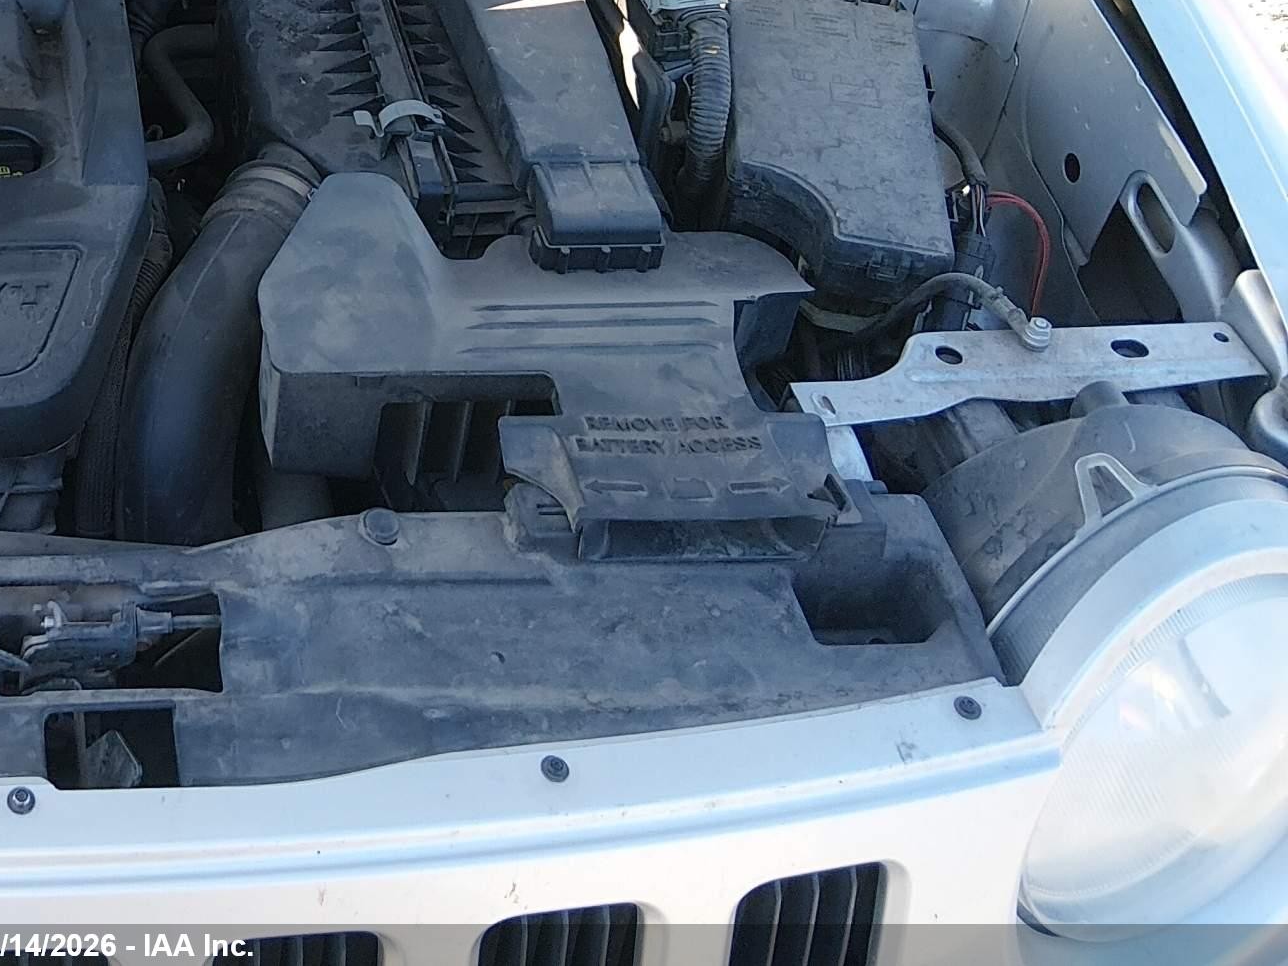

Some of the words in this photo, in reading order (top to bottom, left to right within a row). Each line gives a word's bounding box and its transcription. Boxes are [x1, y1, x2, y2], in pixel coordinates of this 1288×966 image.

[584, 416, 677, 432] REMOVE
[680, 416, 729, 431] FOR
[575, 437, 666, 454] BATTERY
[677, 436, 763, 454] ACCESS
